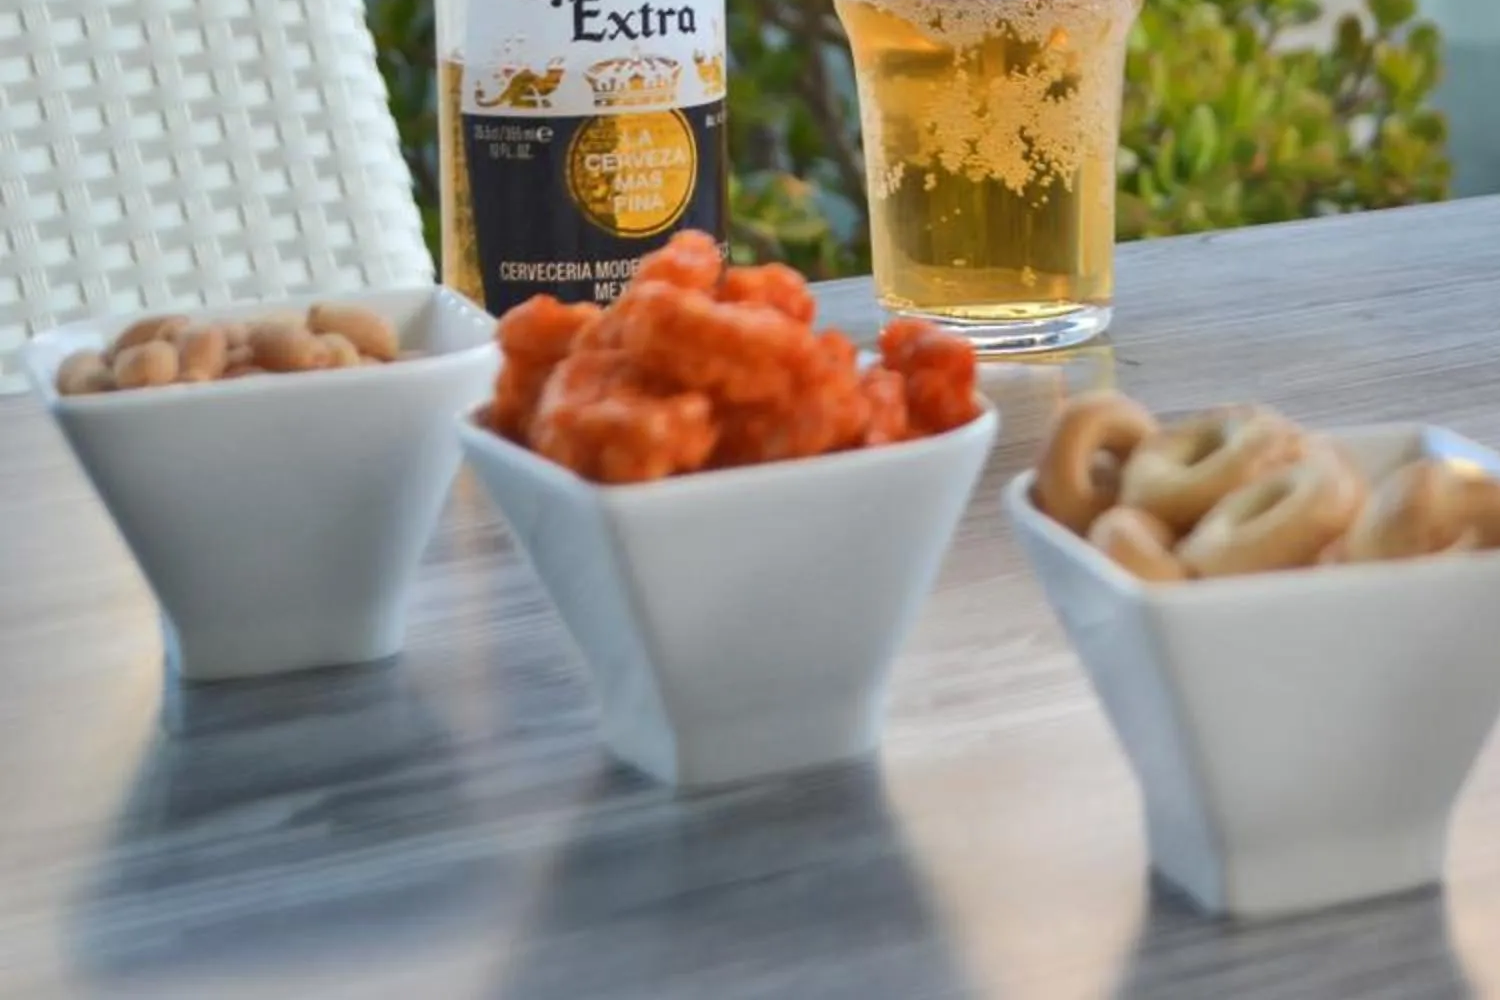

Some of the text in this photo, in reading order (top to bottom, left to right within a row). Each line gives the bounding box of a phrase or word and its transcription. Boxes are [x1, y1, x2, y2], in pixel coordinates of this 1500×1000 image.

[584, 145, 688, 172] CERVEZA
[612, 169, 663, 193] MAS
[613, 193, 666, 213] FINA
[501, 258, 641, 281] CERVECERIA MODE
